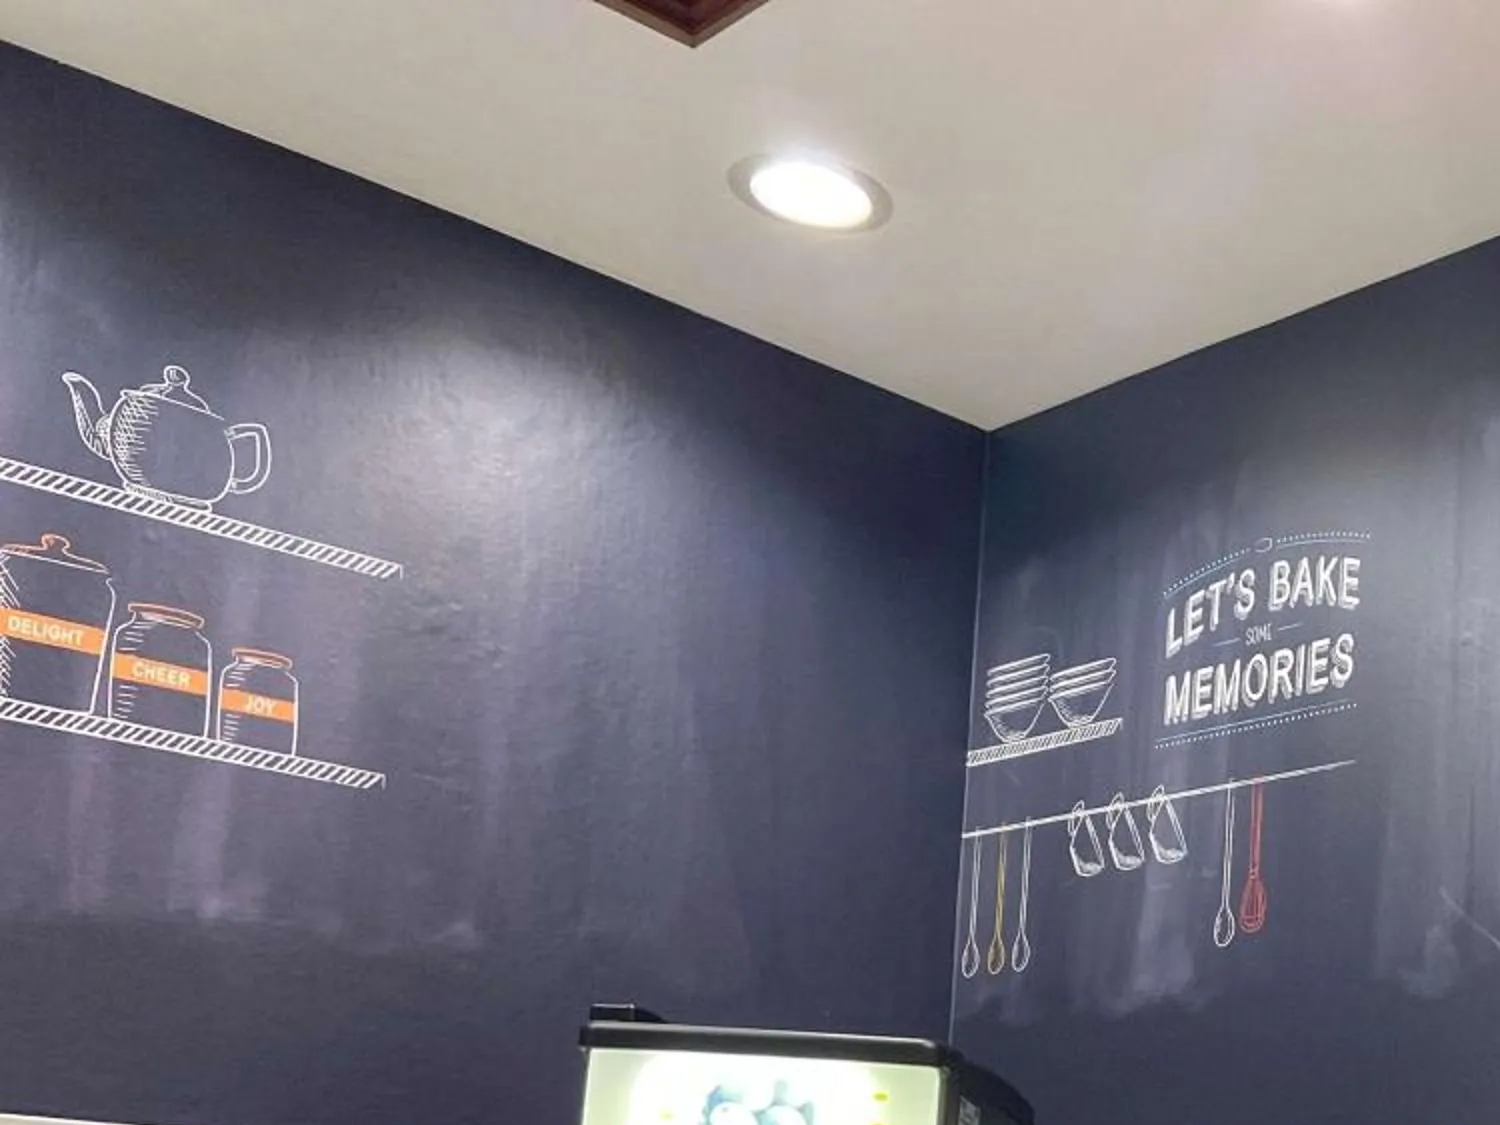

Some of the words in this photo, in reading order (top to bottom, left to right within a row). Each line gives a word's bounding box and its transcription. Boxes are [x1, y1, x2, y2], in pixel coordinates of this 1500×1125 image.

[1165, 568, 1256, 658] LET'S
[1268, 556, 1361, 611] BAKE
[7, 617, 86, 646] DELIGHT
[132, 661, 191, 688] CHEER
[1164, 634, 1354, 726] MEMORIES
[244, 694, 278, 715] JOY
